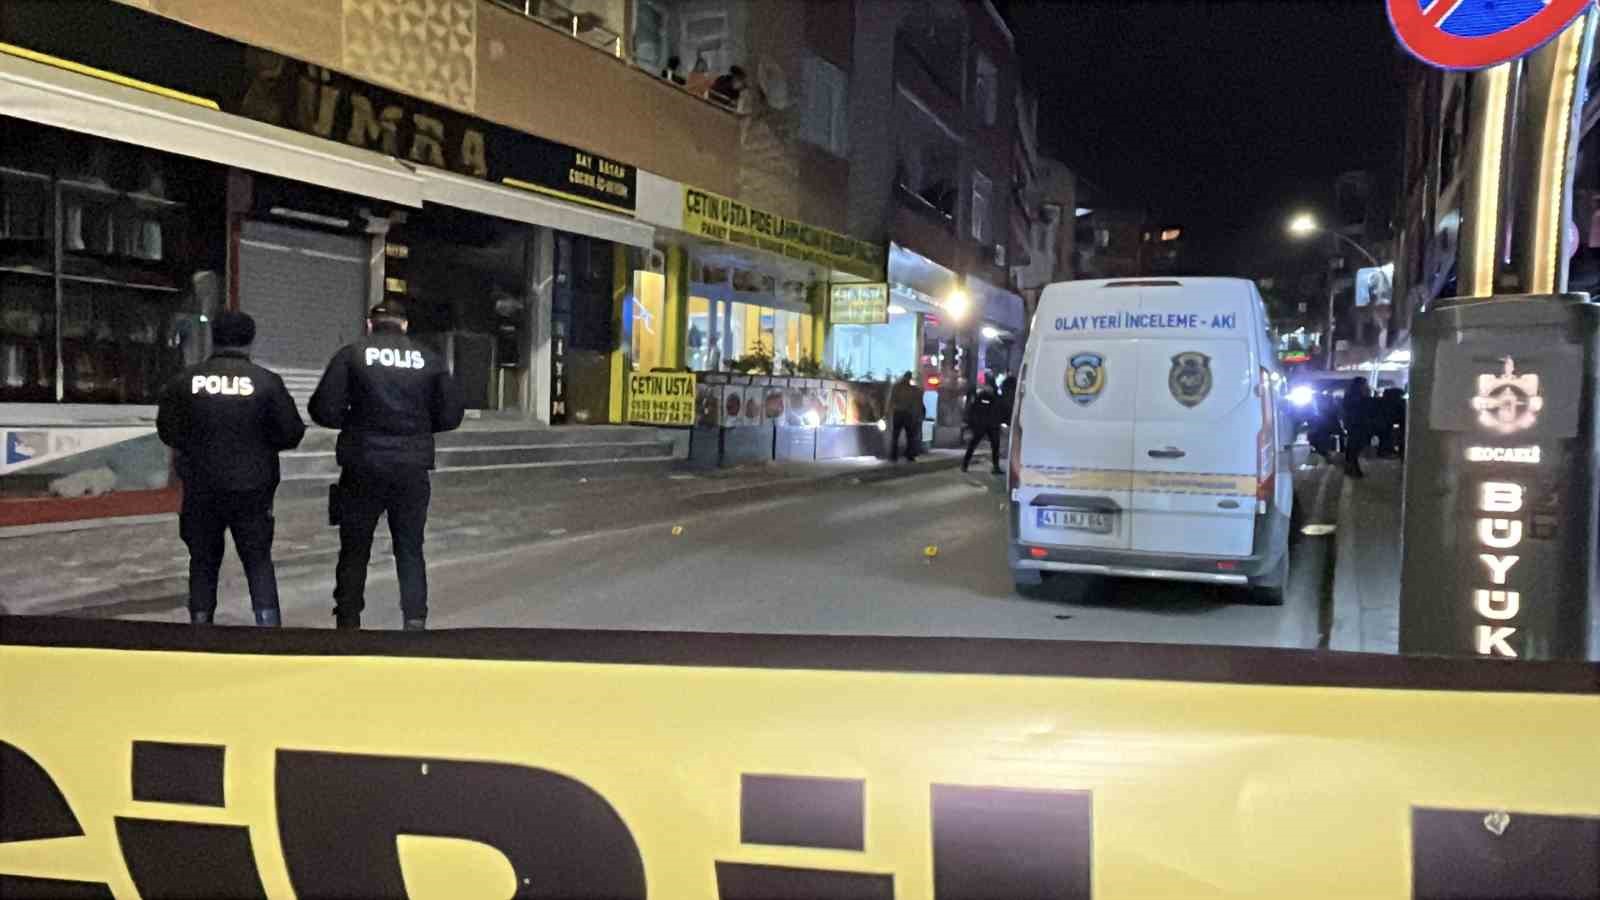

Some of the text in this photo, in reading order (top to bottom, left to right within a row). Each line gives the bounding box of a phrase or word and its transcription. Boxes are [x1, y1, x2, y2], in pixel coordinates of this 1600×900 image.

[1055, 317, 1088, 330] OLAY
[1091, 312, 1121, 329] YERİ
[1125, 311, 1198, 328] İNCELEME
[1212, 312, 1236, 329] AKİ
[665, 377, 694, 397] USTA
[1474, 481, 1523, 657] BÜYÜK
